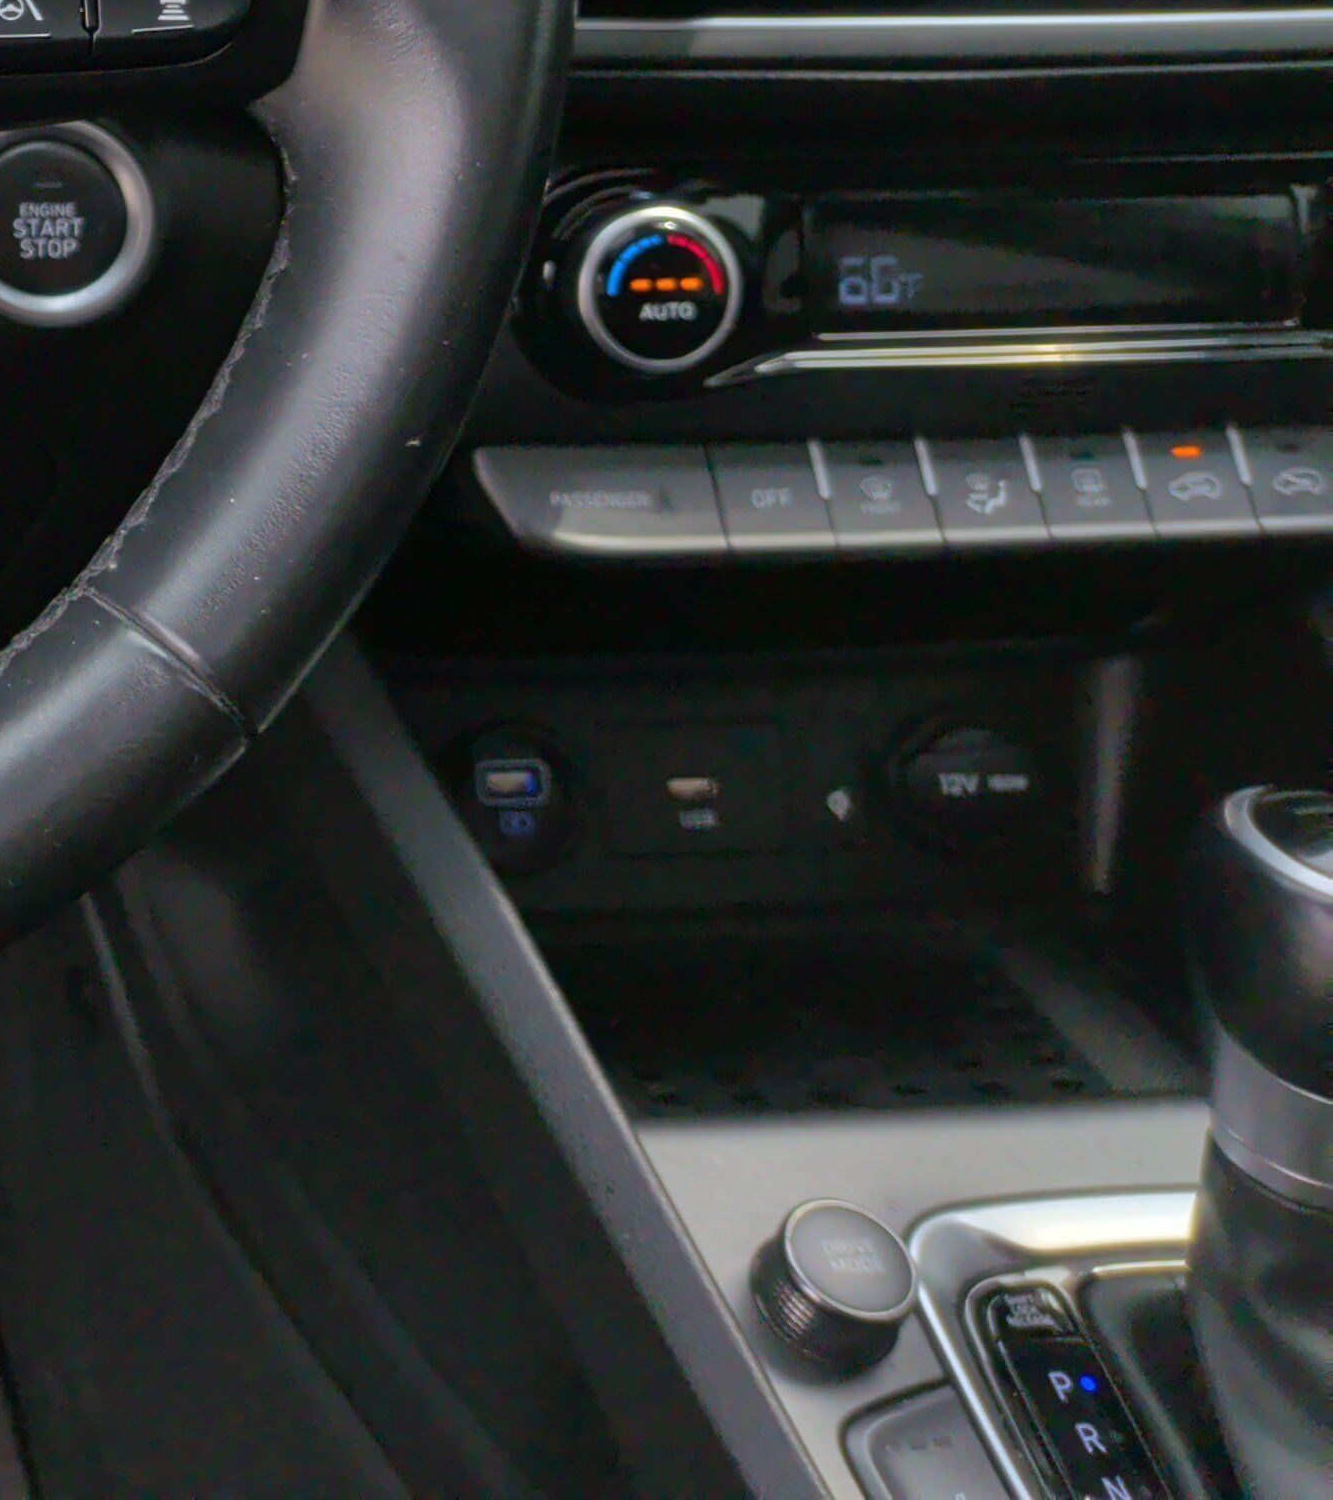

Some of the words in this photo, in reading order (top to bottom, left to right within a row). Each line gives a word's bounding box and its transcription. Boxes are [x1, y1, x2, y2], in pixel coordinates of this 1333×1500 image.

[19, 202, 76, 218] ENGINE
[12, 217, 85, 239] START
[19, 237, 80, 260] STOP
[639, 301, 699, 322] AUTO
[1048, 1370, 1074, 1404] P
[1074, 1422, 1108, 1454] R
[1101, 1474, 1132, 1500] N
